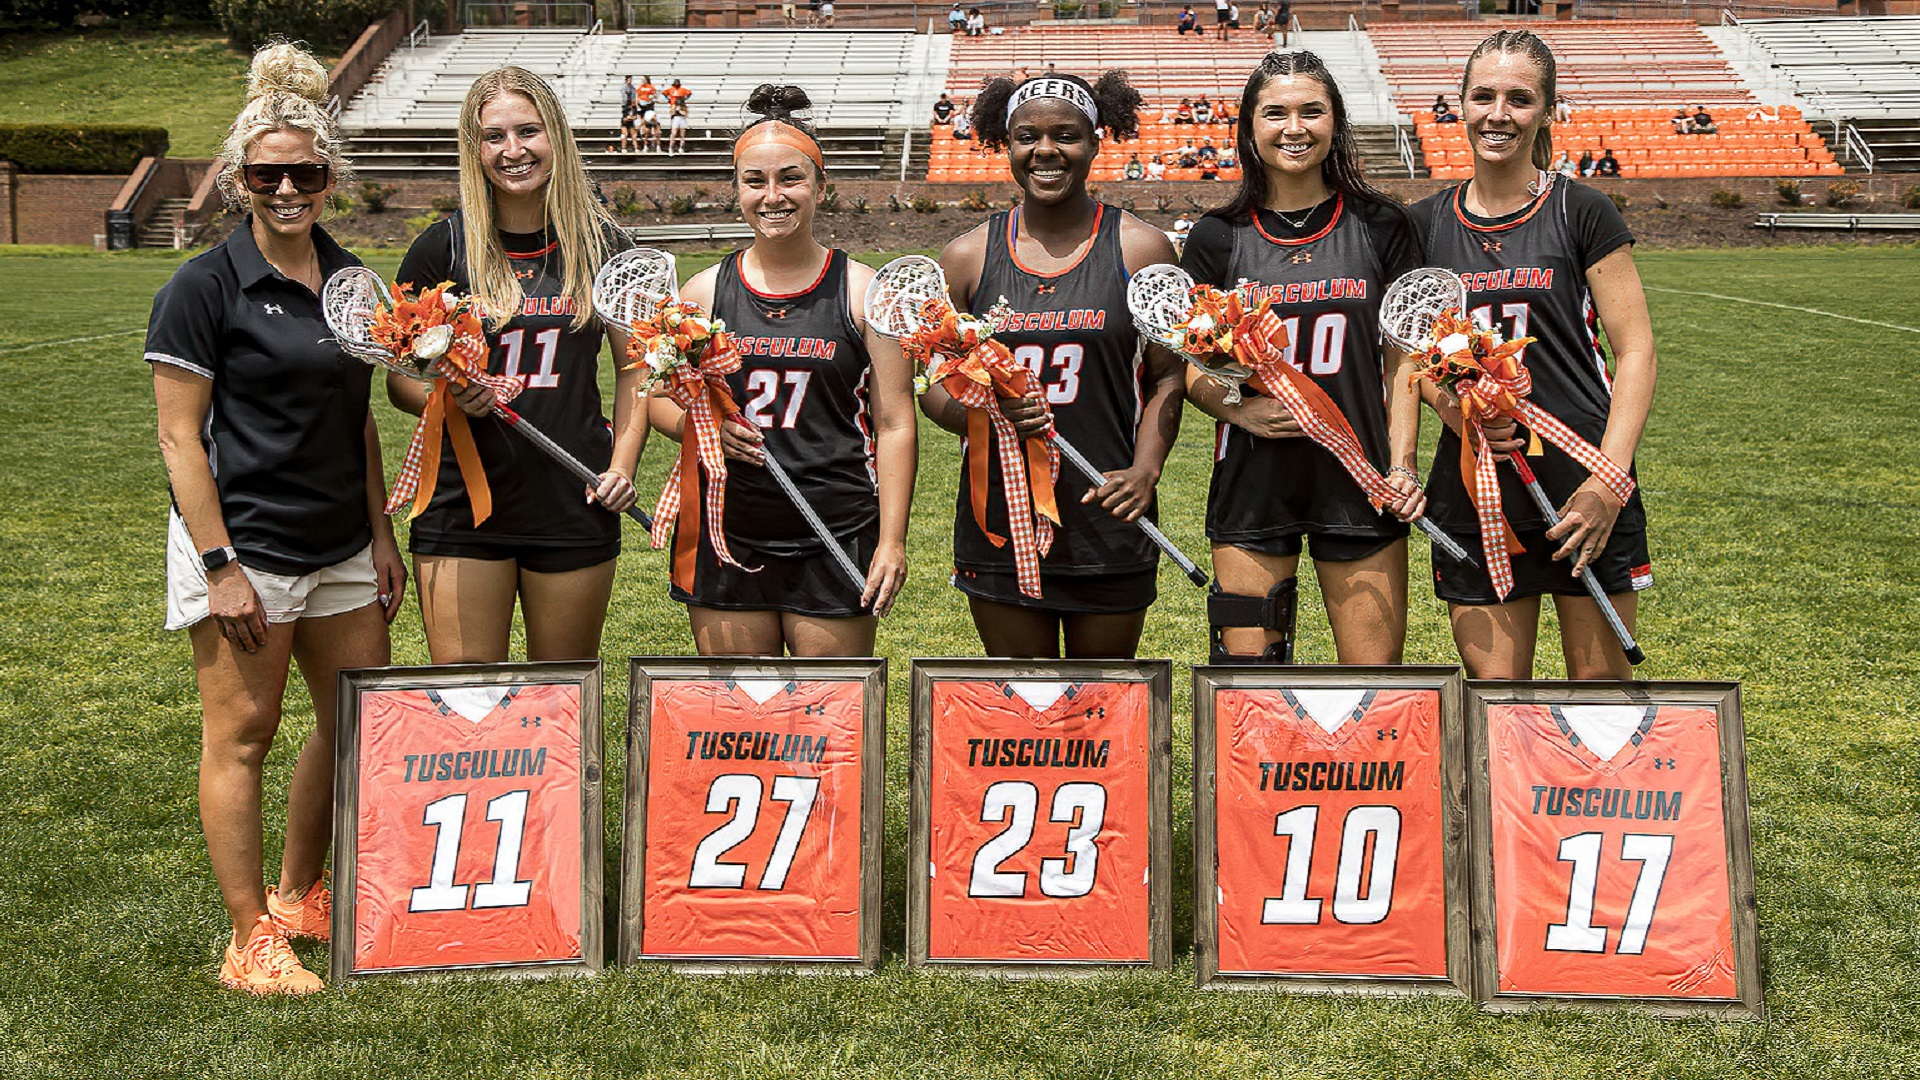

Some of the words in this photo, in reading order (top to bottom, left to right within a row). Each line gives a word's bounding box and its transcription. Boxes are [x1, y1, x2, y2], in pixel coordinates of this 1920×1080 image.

[1018, 81, 1086, 105] NEERS
[1243, 278, 1366, 309] TUSCULUM
[1461, 267, 1553, 292] SCULUM
[995, 309, 1106, 333] USCULUM
[495, 328, 561, 389] 11
[726, 333, 836, 360] SCULUM
[745, 369, 812, 429] 27
[404, 747, 547, 782] TUSCULUM
[686, 731, 827, 763] TUSCULUM
[967, 739, 1110, 768] TUSCULUM
[1259, 761, 1404, 791] TUSCULUM
[1532, 785, 1682, 820] TUSCULUM
[688, 774, 820, 890] 27
[968, 781, 1107, 898] 23
[408, 790, 532, 913] 11
[1260, 804, 1402, 925] 10
[1545, 832, 1675, 955] 17
